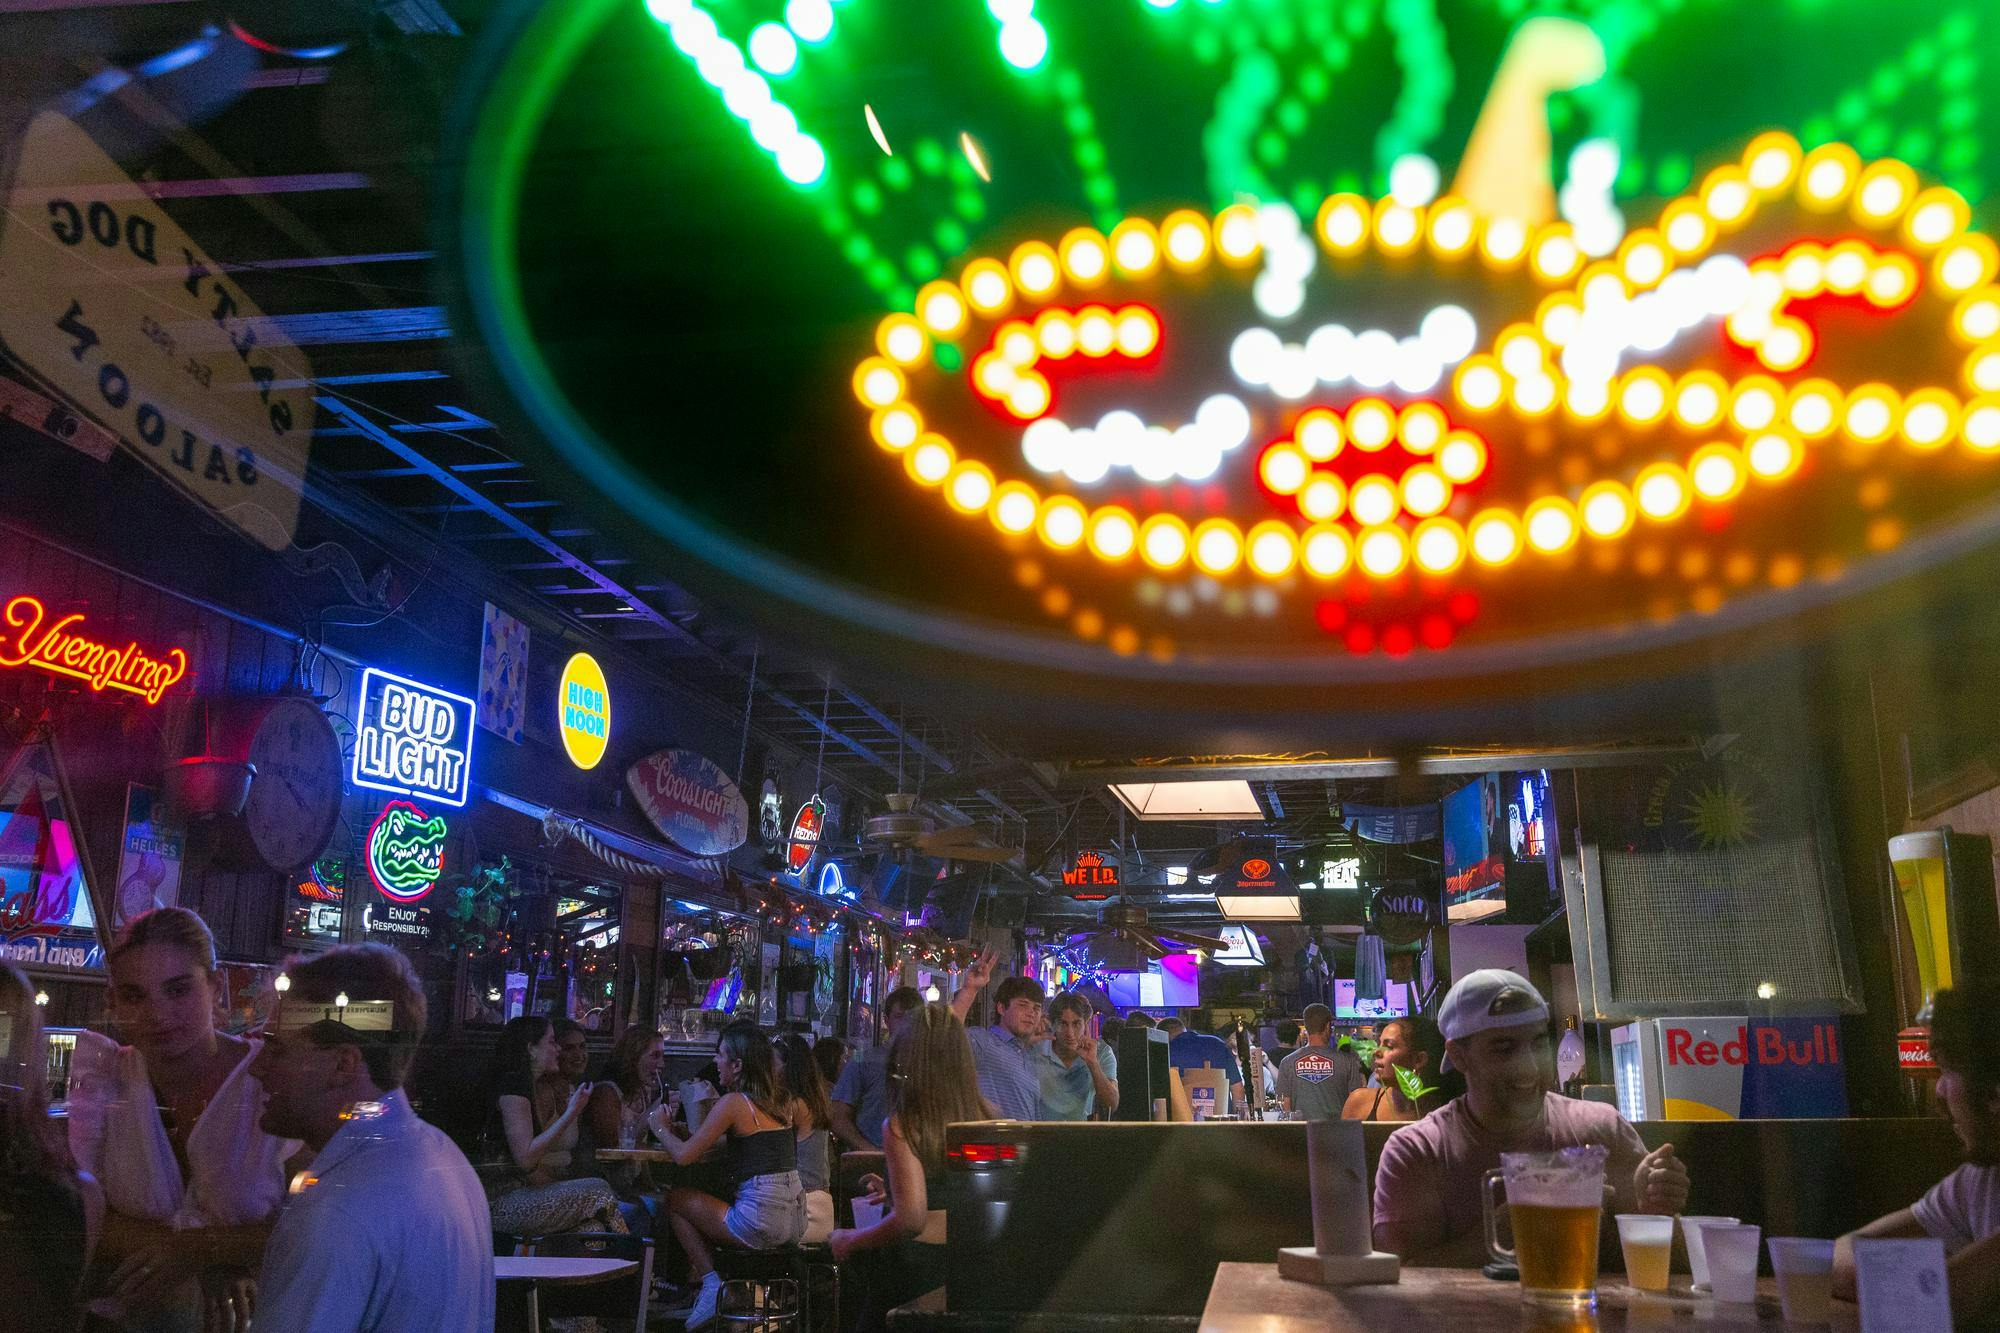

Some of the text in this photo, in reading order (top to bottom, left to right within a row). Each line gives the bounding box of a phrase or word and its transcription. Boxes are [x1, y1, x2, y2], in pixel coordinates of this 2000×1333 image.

[0, 597, 185, 704] Yuengling
[567, 681, 604, 713] HIGH
[381, 684, 456, 744] BUD
[563, 705, 605, 738] NOON
[360, 726, 465, 793] LIGHT
[695, 788, 731, 817] LIGHT
[131, 837, 178, 857] HELLES
[372, 919, 421, 935] RESPONSIBLY
[387, 906, 418, 921] ENJOY
[1665, 1024, 1839, 1066] Red Bull
[1297, 1061, 1331, 1070] COSTA
